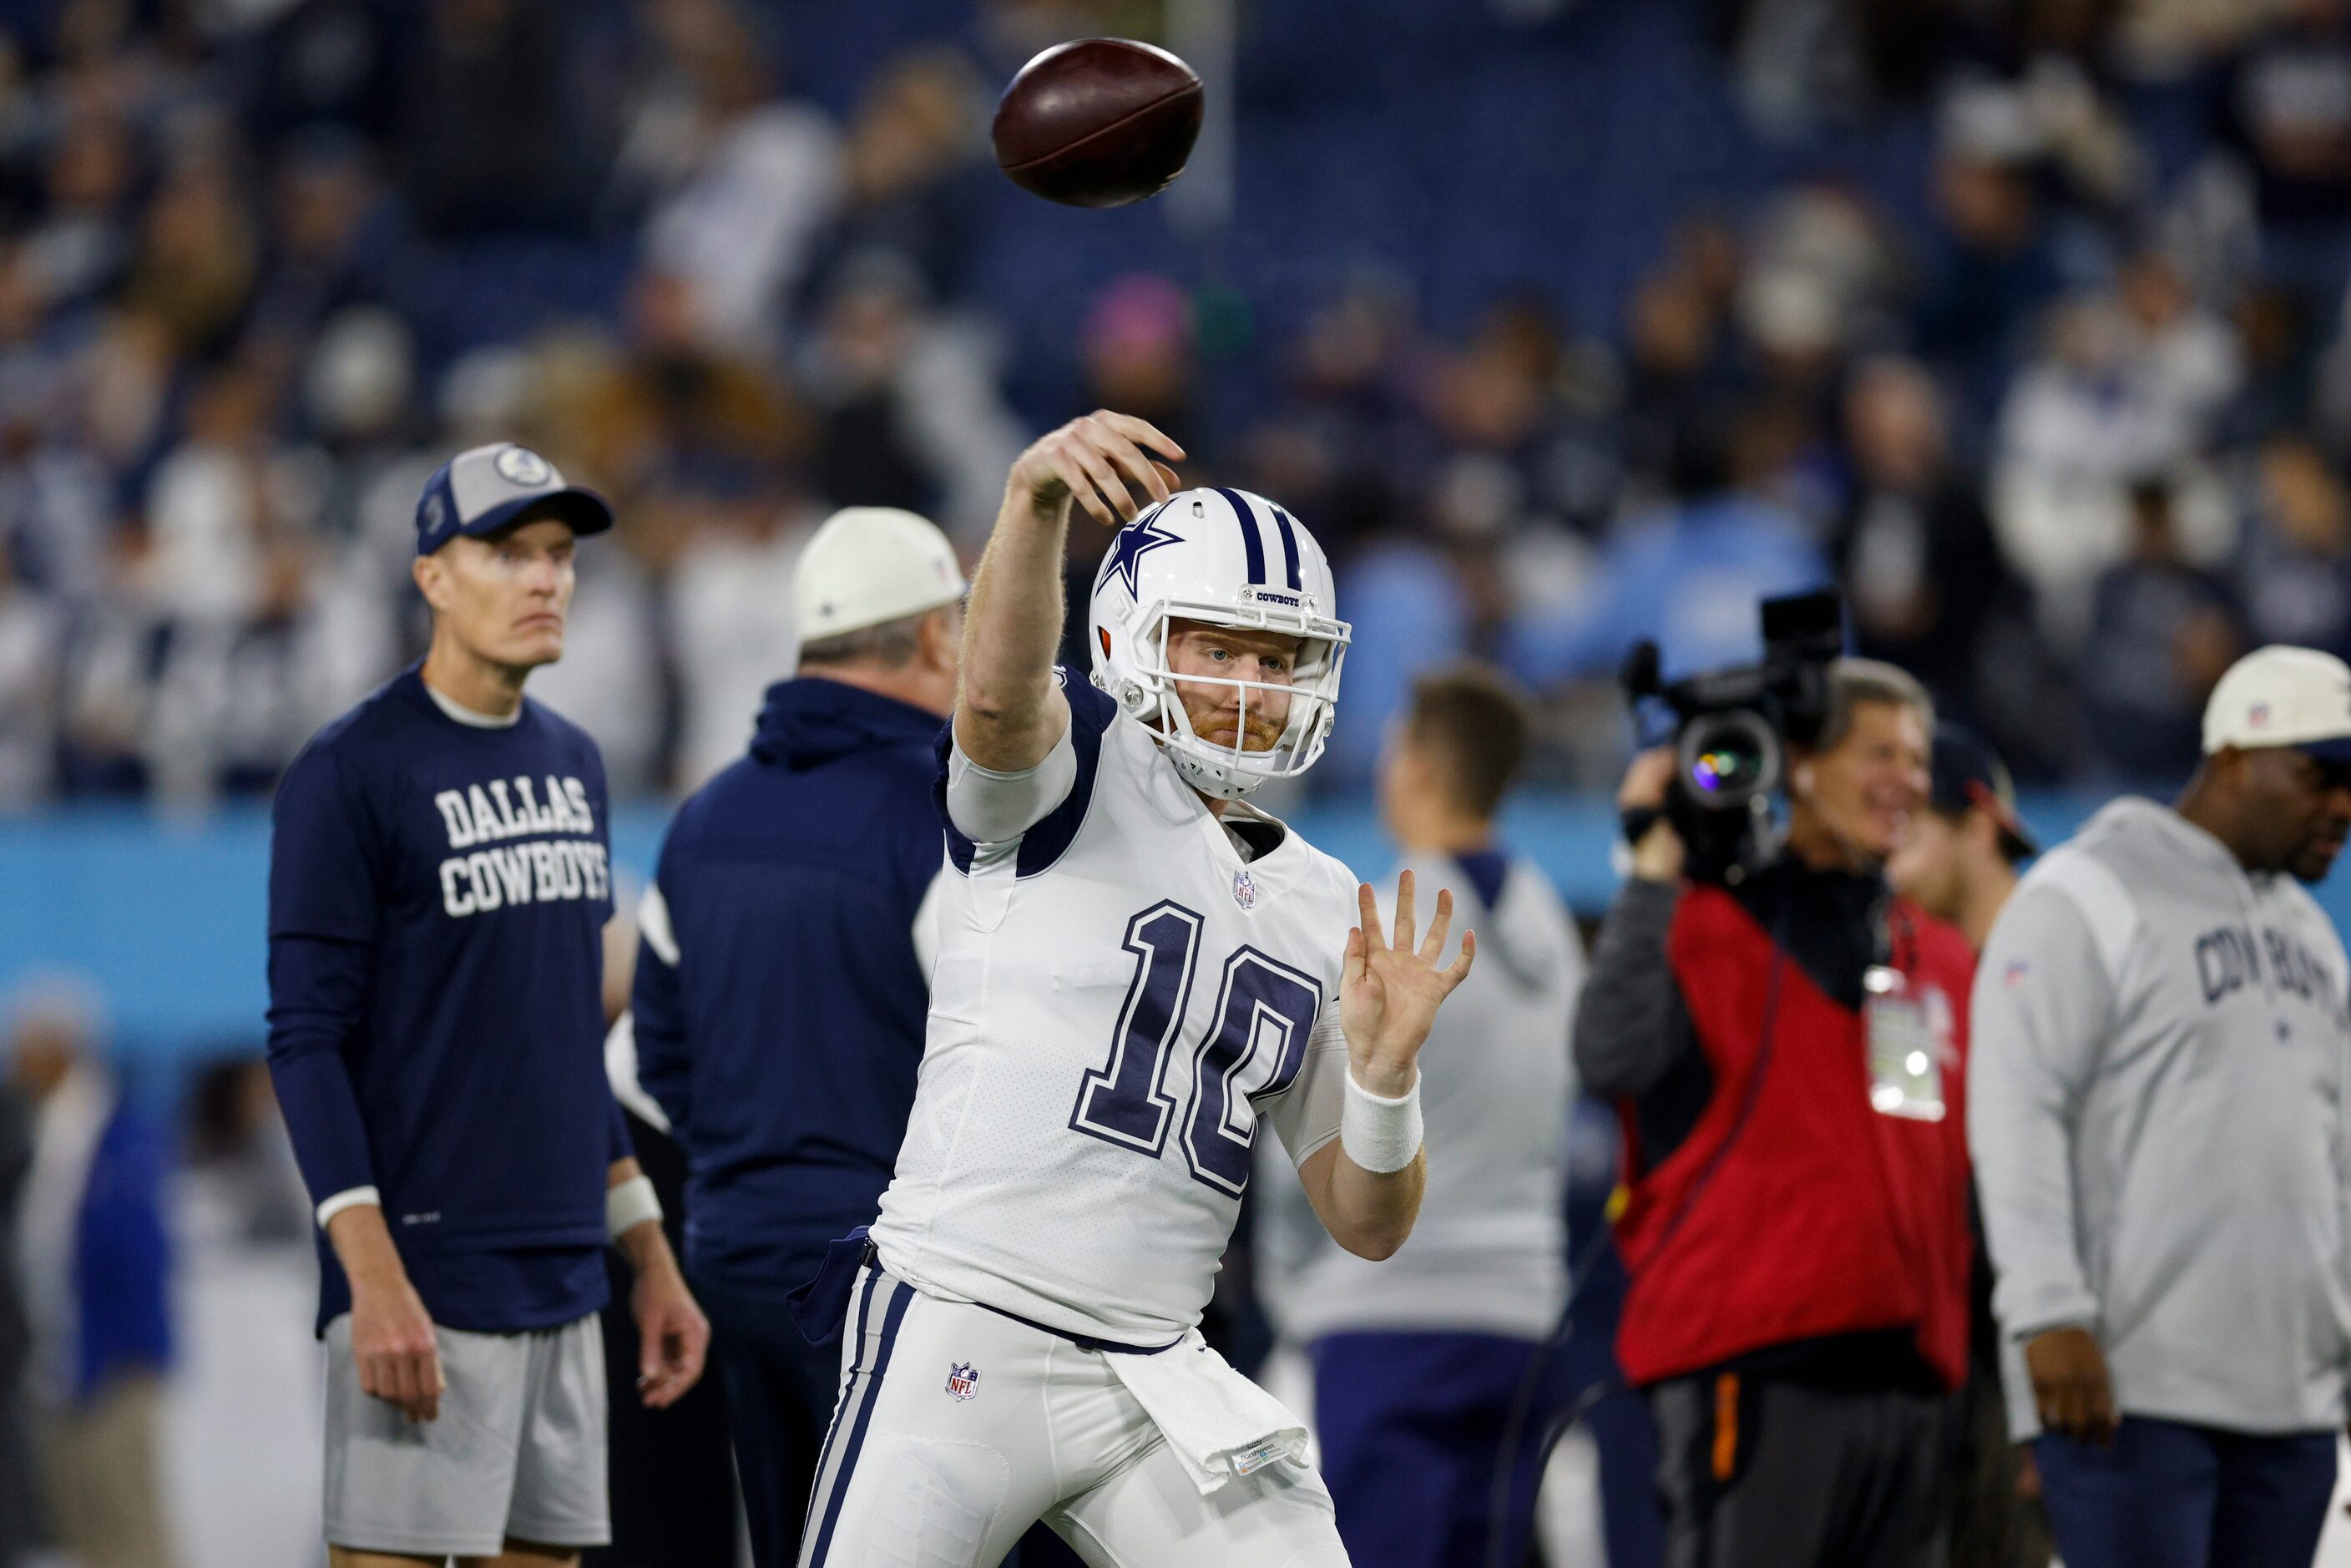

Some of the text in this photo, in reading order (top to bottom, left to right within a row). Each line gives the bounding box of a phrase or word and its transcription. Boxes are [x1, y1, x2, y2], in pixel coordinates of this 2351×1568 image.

[1256, 592, 1300, 607] COWBOYS
[435, 774, 594, 850] DALLAS
[439, 840, 609, 918] COWBOYS
[1238, 885, 1253, 903] NFL
[1068, 898, 1322, 1201] 10
[950, 1378, 972, 1394] NFL
[1241, 1444, 1276, 1460] northwest
